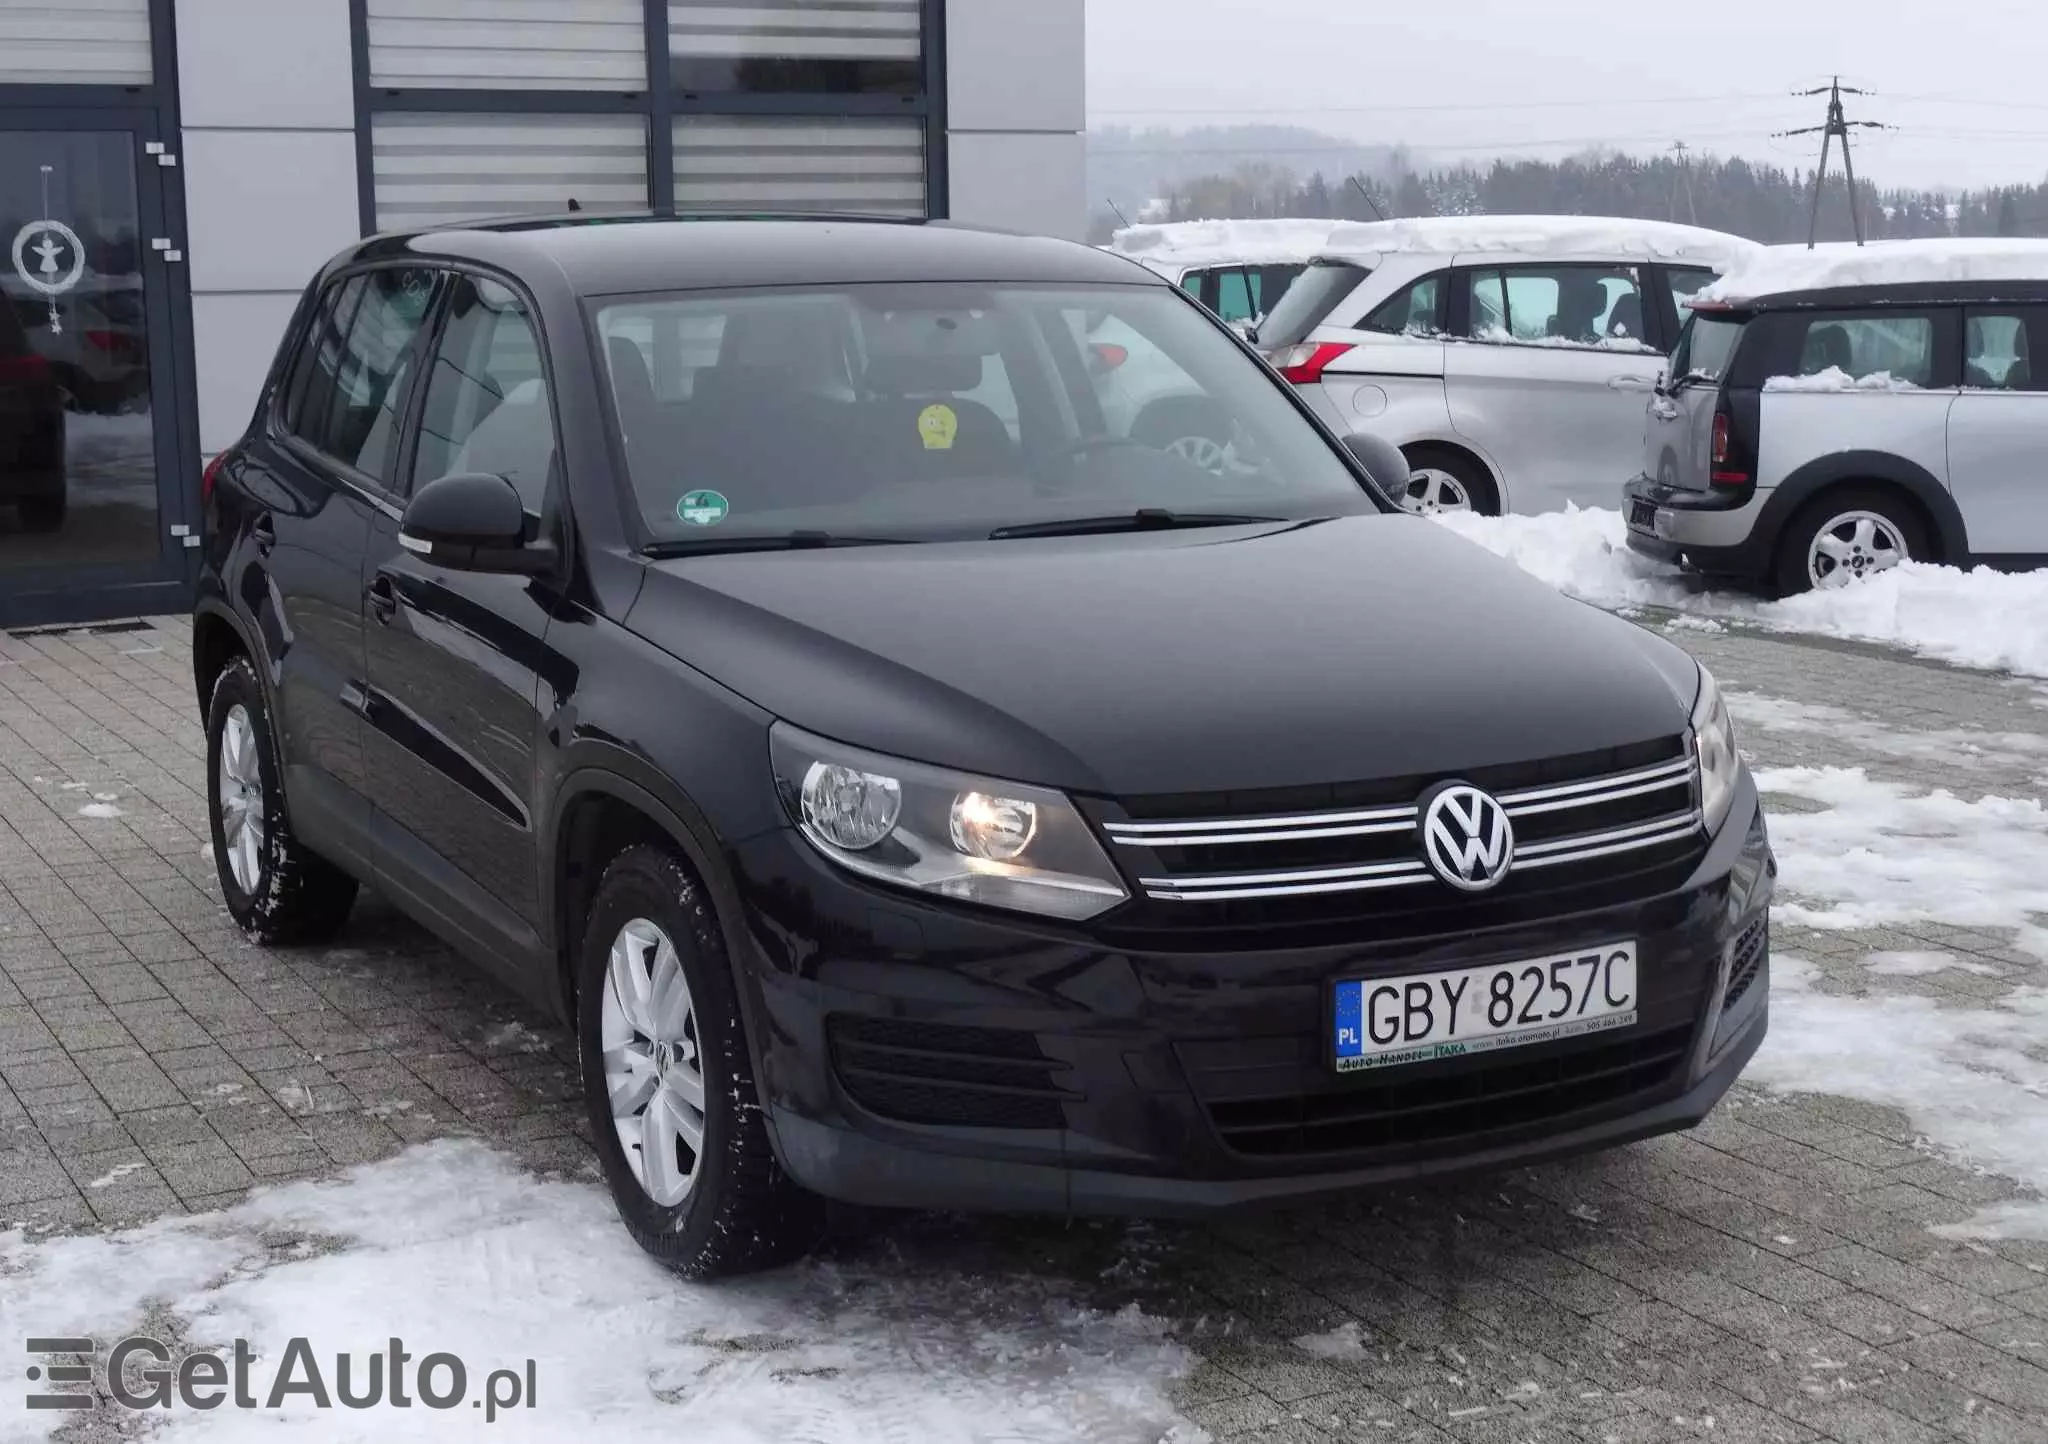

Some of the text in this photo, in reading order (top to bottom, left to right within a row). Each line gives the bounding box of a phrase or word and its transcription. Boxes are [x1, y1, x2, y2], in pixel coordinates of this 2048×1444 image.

[1427, 787, 1511, 890] VW
[1338, 1028, 1358, 1045] PL
[1368, 950, 1630, 1044] GBY 8257C
